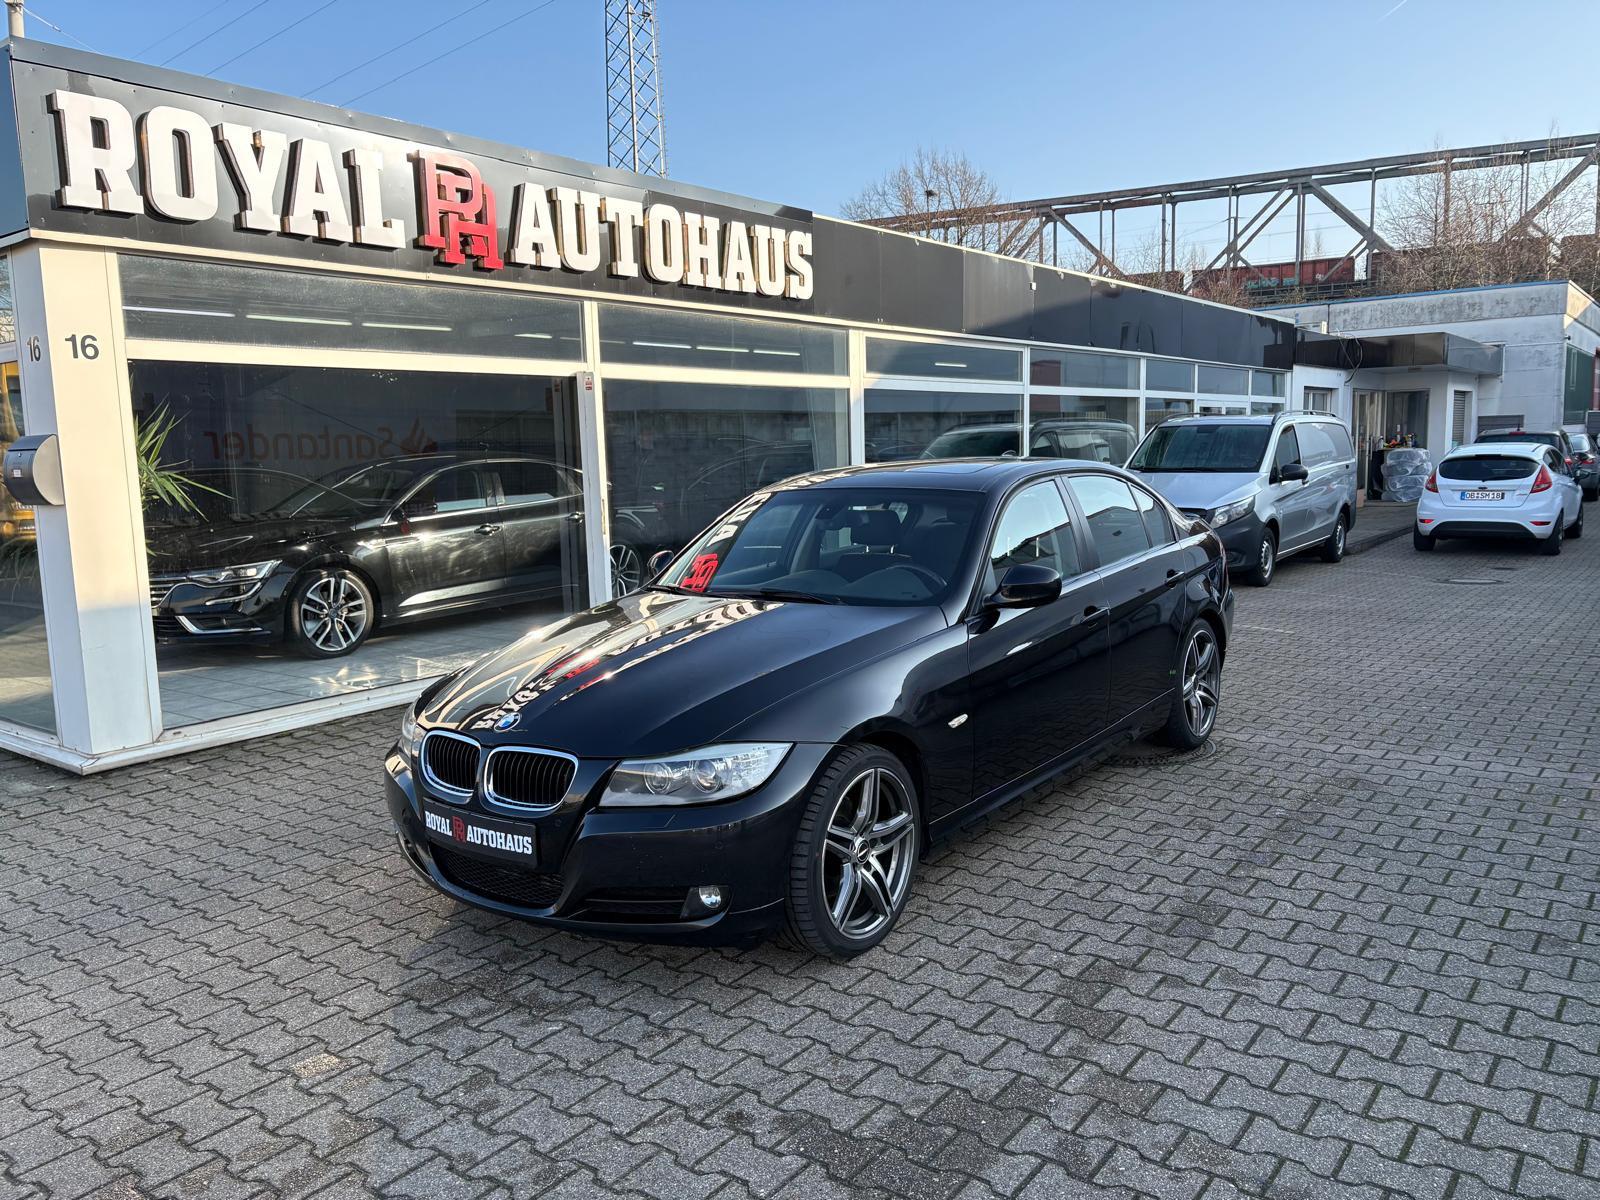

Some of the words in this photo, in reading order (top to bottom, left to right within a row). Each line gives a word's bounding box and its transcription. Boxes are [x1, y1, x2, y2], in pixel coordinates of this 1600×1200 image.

[50, 89, 406, 250] ROYAL
[509, 182, 814, 300] AUTOHAUS
[27, 335, 41, 362] 16
[65, 334, 100, 360] 16
[425, 810, 453, 837] ROYAL
[466, 825, 533, 855] AUTOHAUS
